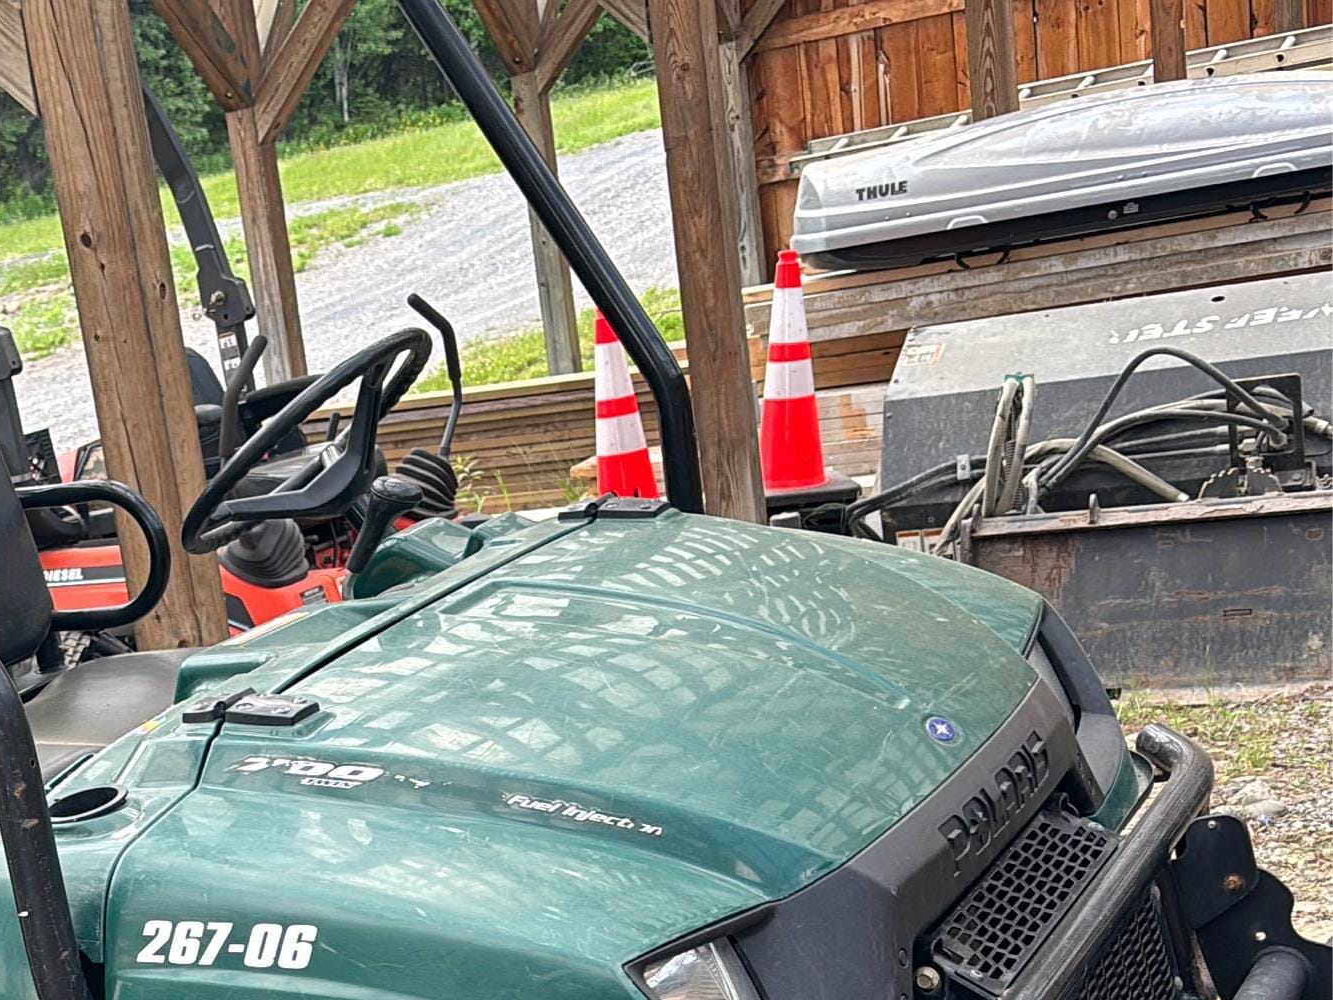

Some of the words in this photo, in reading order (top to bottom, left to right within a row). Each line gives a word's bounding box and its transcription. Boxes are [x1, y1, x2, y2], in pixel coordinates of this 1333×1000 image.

[855, 180, 908, 201] THULE
[300, 777, 363, 790] TWIN
[506, 793, 563, 813] Fuel
[937, 730, 1049, 877] POLARIS
[136, 919, 318, 970] 267-06
